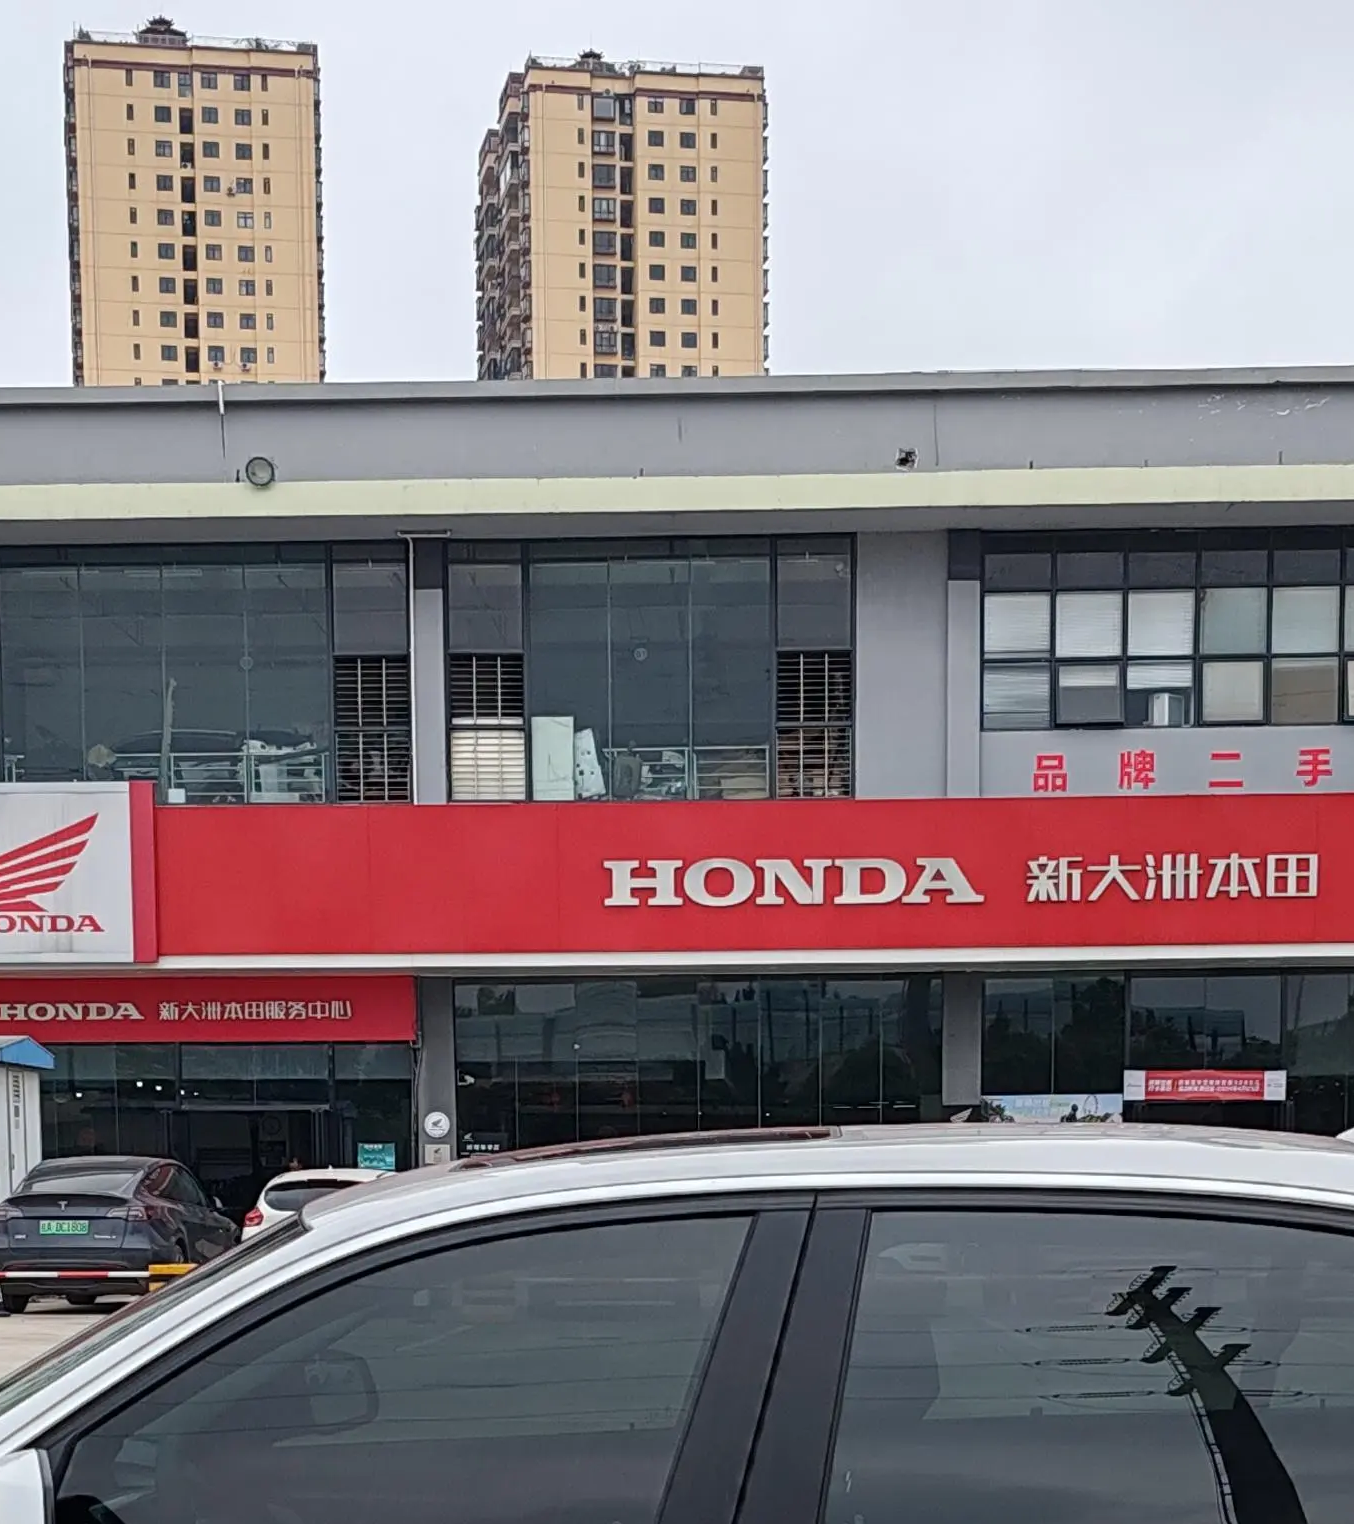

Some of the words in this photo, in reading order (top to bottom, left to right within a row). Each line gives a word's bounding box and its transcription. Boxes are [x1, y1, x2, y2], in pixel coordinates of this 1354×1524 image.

[603, 857, 984, 907] HONDA
[1026, 853, 1320, 903] 新大洲本田
[158, 1000, 353, 1021] 新大洲本田服务中心
